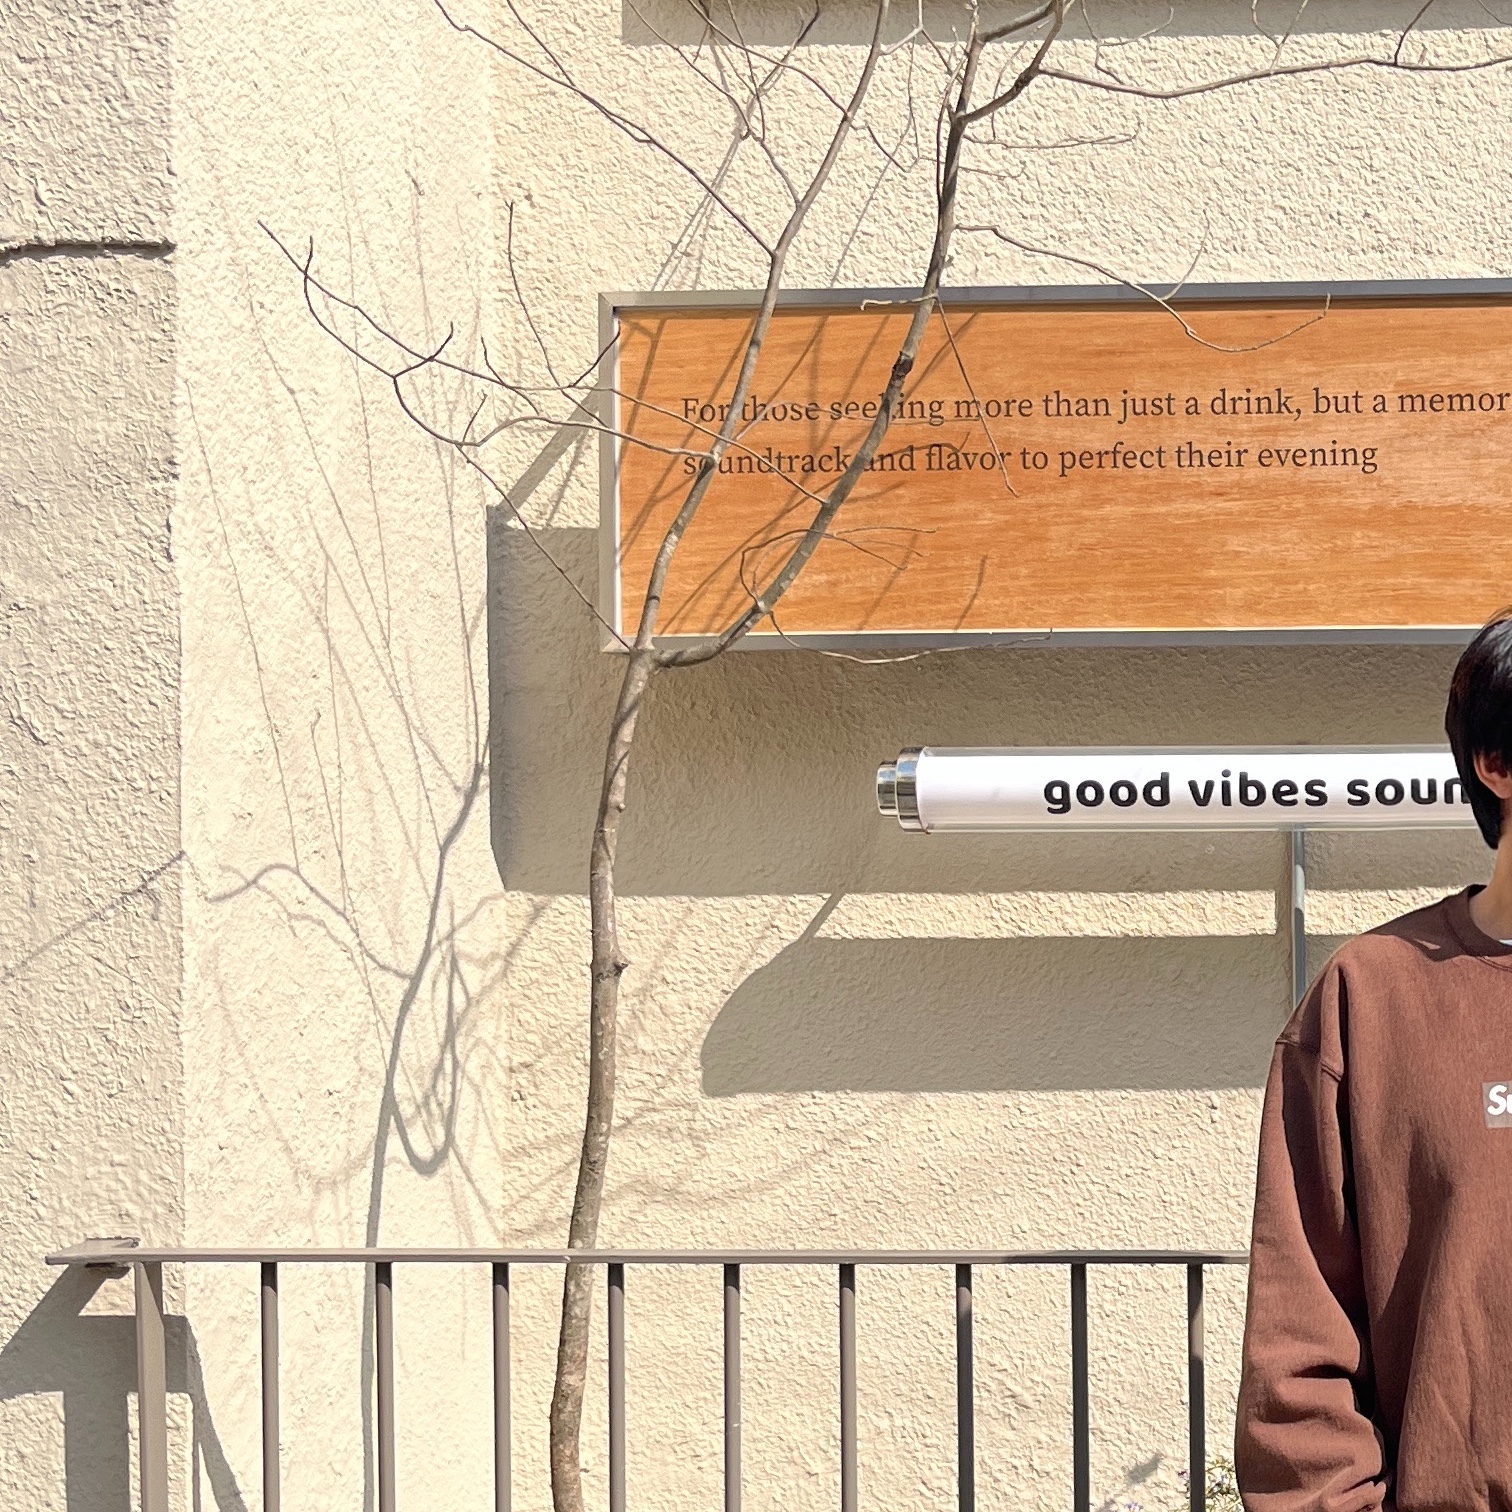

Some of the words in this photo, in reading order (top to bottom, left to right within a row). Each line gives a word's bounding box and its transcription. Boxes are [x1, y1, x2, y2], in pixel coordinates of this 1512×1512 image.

[681, 397, 732, 422] For
[741, 394, 820, 422] those
[829, 391, 945, 427] seeing
[954, 398, 1034, 419] more
[1043, 390, 1111, 418] than
[1117, 389, 1176, 425] just
[1184, 396, 1201, 416] a
[1210, 387, 1302, 422] drink,
[1312, 387, 1364, 414] but
[1372, 393, 1389, 414] a
[925, 443, 1013, 472] flavor
[1019, 446, 1049, 470] to
[1058, 441, 1167, 477] perfect
[1176, 440, 1249, 469] their
[1257, 439, 1379, 475] evening
[1043, 772, 1171, 814] good
[1187, 768, 1329, 808] vibes
